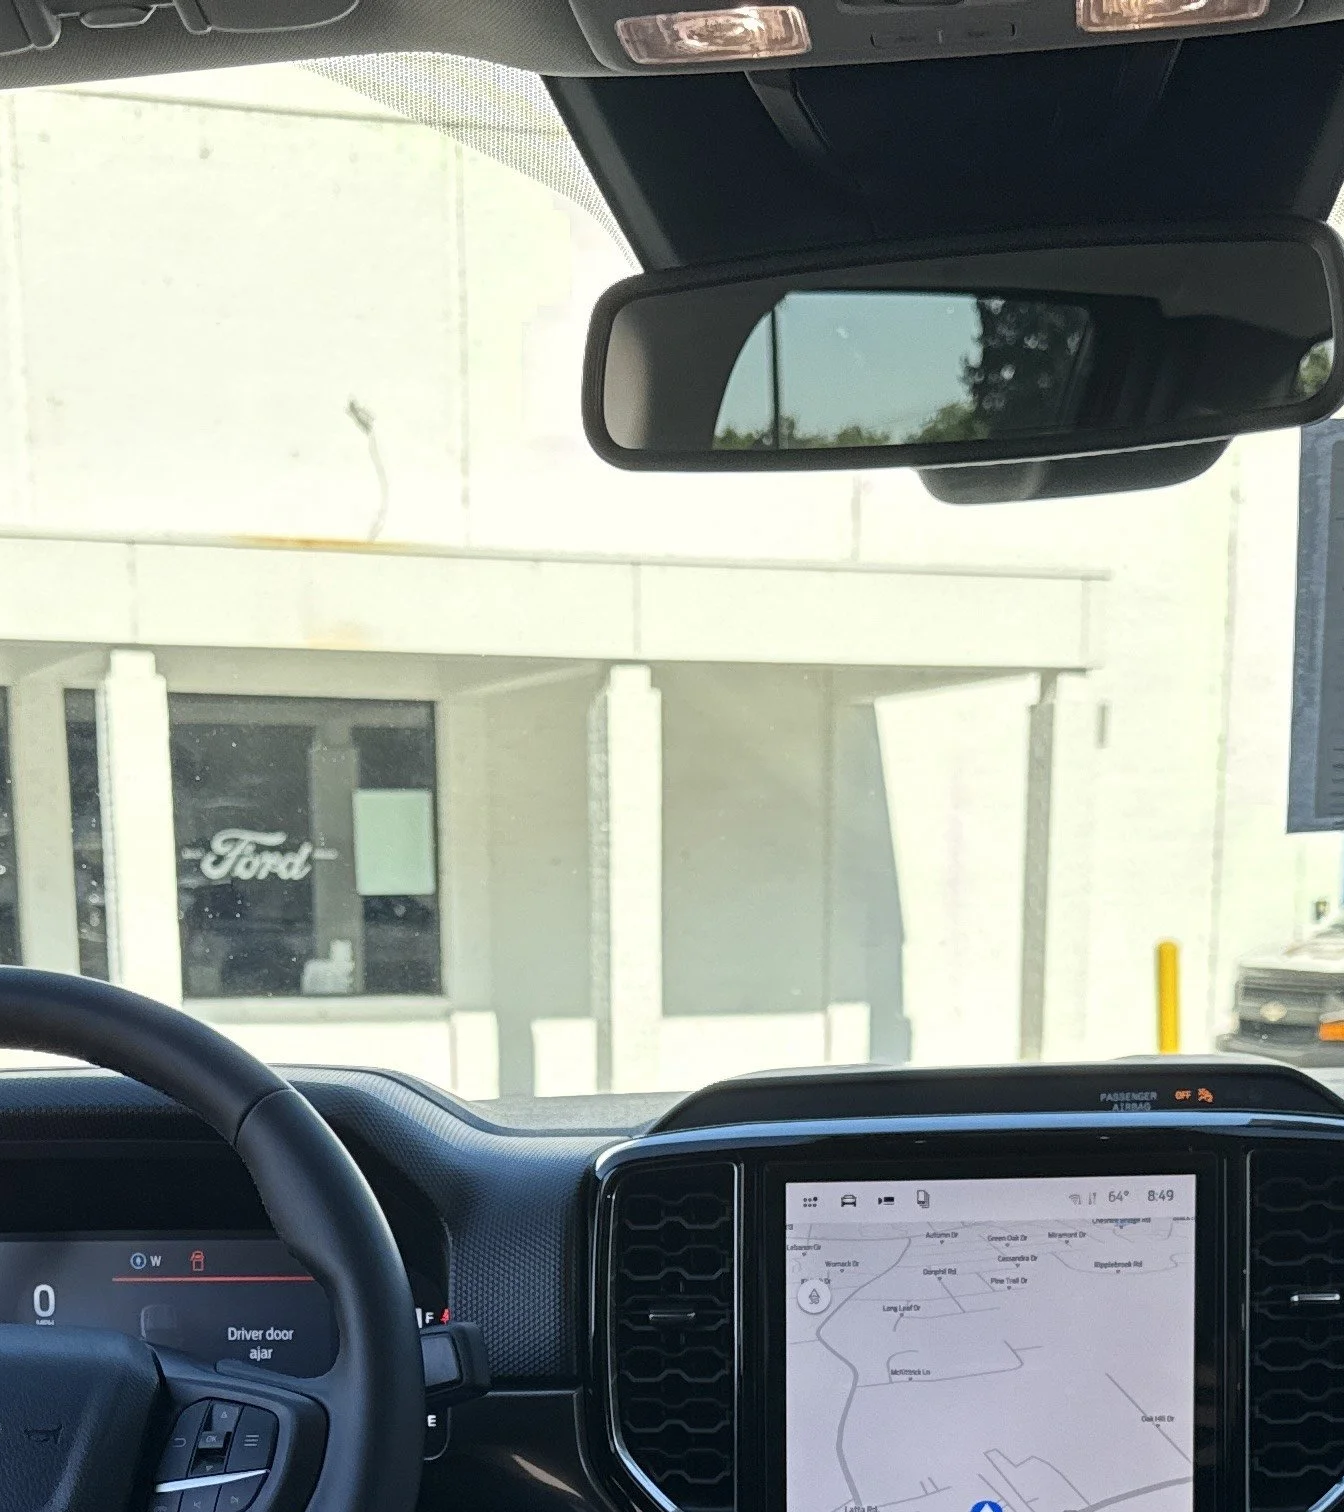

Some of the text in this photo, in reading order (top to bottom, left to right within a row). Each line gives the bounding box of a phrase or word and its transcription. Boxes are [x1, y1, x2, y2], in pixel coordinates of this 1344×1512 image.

[200, 828, 313, 881] Ford
[1099, 1090, 1192, 1102] PASSENGER OFF
[1112, 1102, 1152, 1112] AIRBAG
[1108, 1189, 1175, 1203] 64° 8:49
[149, 1255, 162, 1267] W
[33, 1284, 56, 1318] 0
[424, 1311, 435, 1324] F
[227, 1326, 295, 1341] Driver door
[249, 1345, 274, 1362] ajar
[427, 1414, 437, 1428] E
